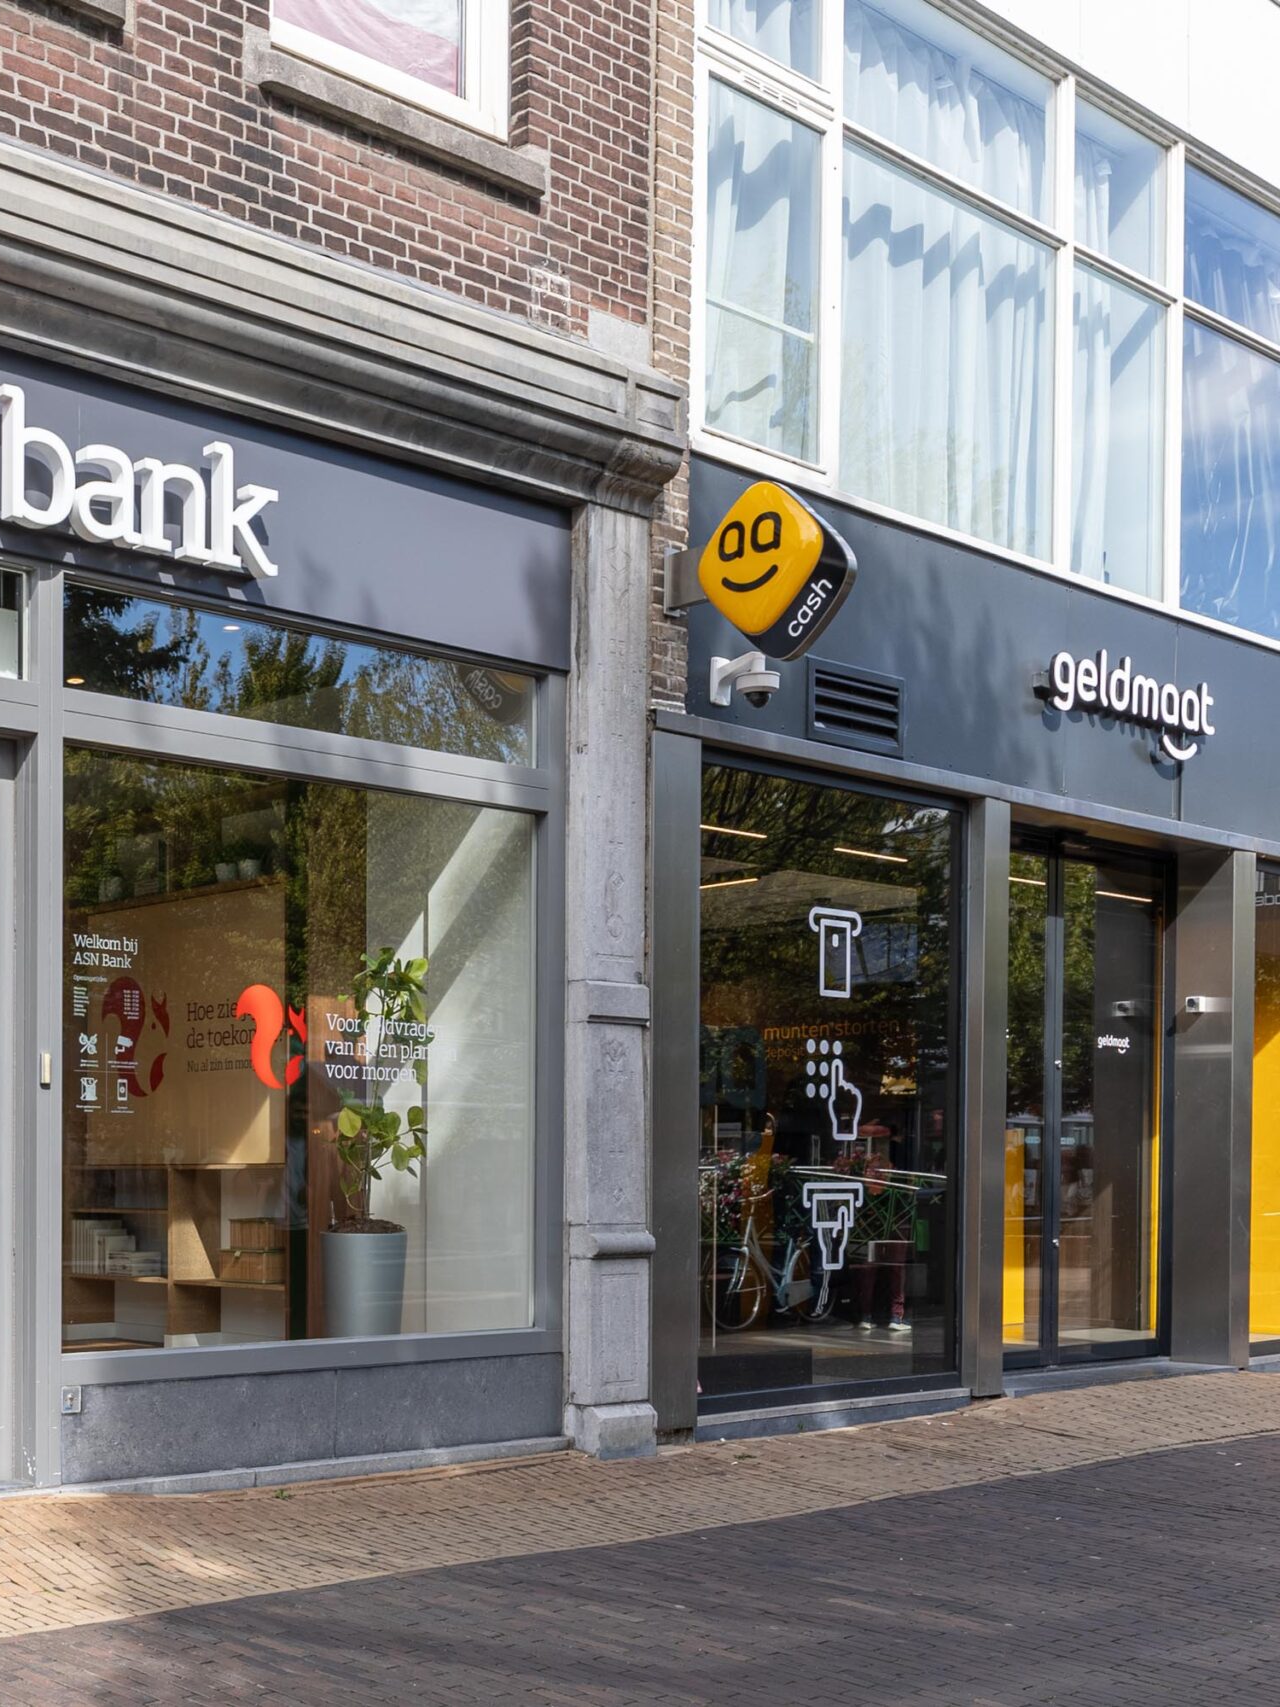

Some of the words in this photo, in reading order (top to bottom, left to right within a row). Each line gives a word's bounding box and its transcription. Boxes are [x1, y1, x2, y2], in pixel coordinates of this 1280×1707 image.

[788, 579, 833, 637] cash
[1053, 649, 1216, 736] geldmaat
[73, 934, 121, 952] Welkom
[123, 936, 138, 955] bij
[73, 952, 100, 966] ASN
[102, 953, 131, 969] Bank
[186, 1002, 214, 1022] Hoe
[217, 998, 238, 1019] zie
[325, 1013, 361, 1033] Voor
[763, 1023, 829, 1041] munten
[833, 1018, 900, 1037] storten
[186, 1027, 205, 1049] de
[1097, 1034, 1131, 1049] geldmaat
[325, 1040, 354, 1056] van
[379, 1044, 397, 1059] en
[324, 1064, 360, 1080] voor
[361, 1065, 417, 1083] morgen
